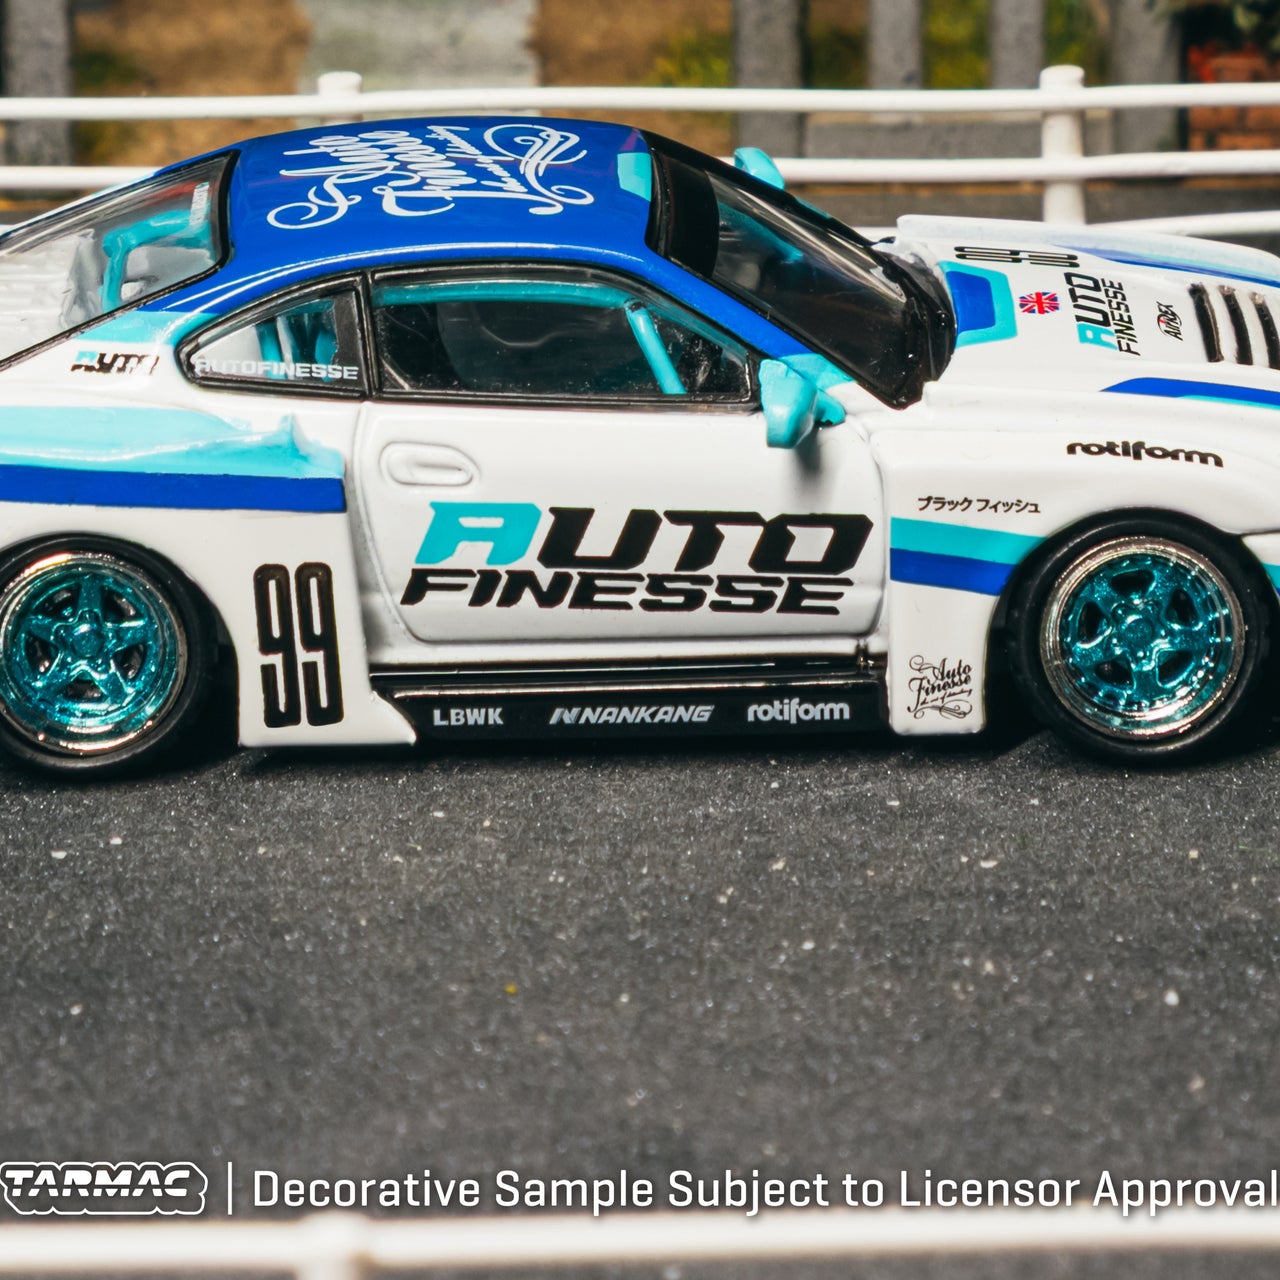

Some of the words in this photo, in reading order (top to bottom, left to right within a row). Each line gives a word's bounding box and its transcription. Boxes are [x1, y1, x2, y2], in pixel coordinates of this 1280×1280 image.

[1064, 272, 1119, 351] AUTO
[1101, 277, 1142, 357] FINESSE
[1066, 441, 1225, 468] rotiform
[414, 501, 874, 575] AUTO
[399, 568, 855, 615] FINESSE
[253, 562, 345, 728] 99
[433, 707, 504, 726] LBWK
[572, 705, 716, 725] NANKANG
[747, 698, 851, 725] rotiform
